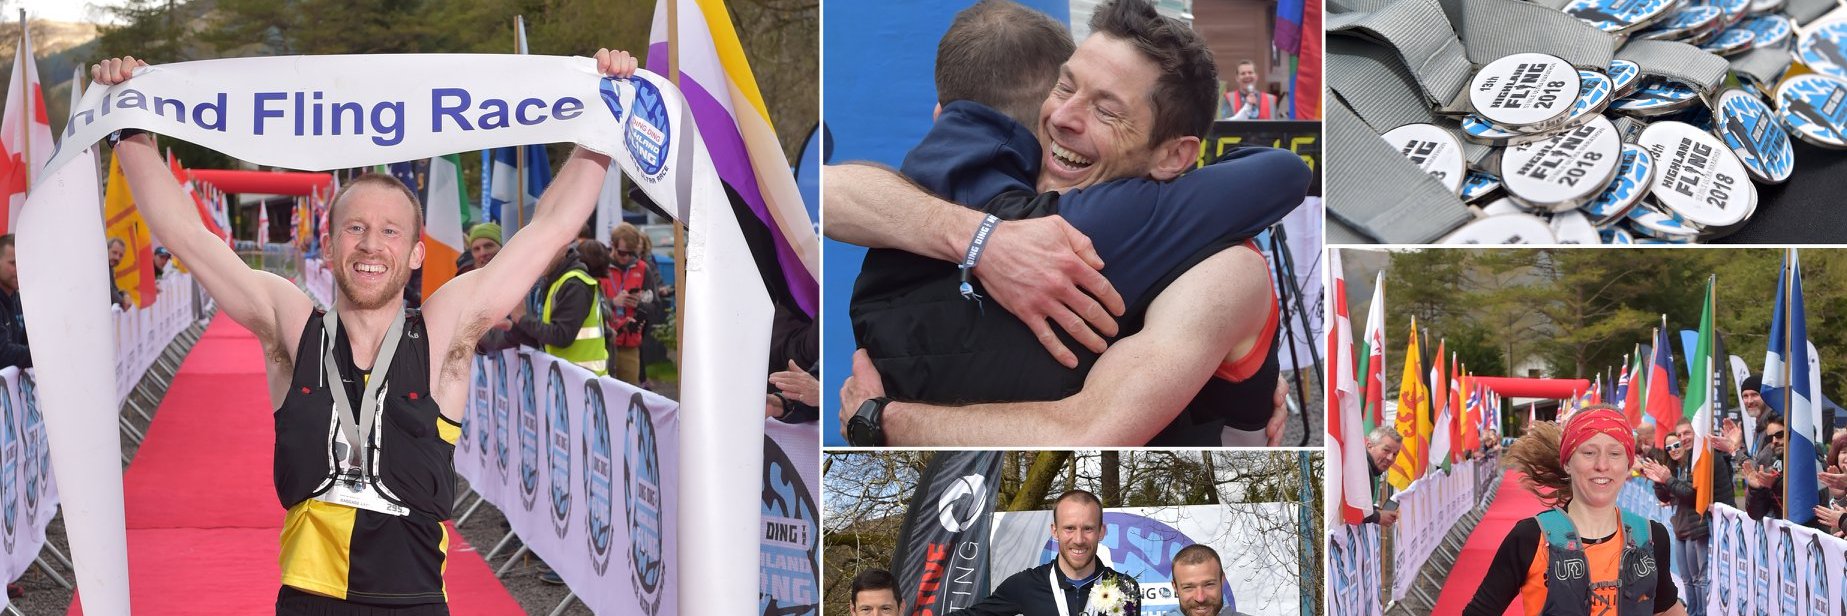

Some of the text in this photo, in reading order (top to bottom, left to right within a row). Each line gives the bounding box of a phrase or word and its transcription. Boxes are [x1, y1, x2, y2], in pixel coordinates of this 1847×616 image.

[1480, 76, 1499, 92] 13th
[1490, 63, 1528, 108] HIGHLAND
[1533, 80, 1566, 109] 2018
[46, 88, 584, 160] hland Fling Race
[1558, 151, 1603, 187] 2018
[1661, 137, 1693, 189] HIGHLAND
[1706, 172, 1735, 210] 2018
[966, 246, 979, 265] DING
[766, 521, 798, 544] DING
[949, 541, 979, 614] TING
